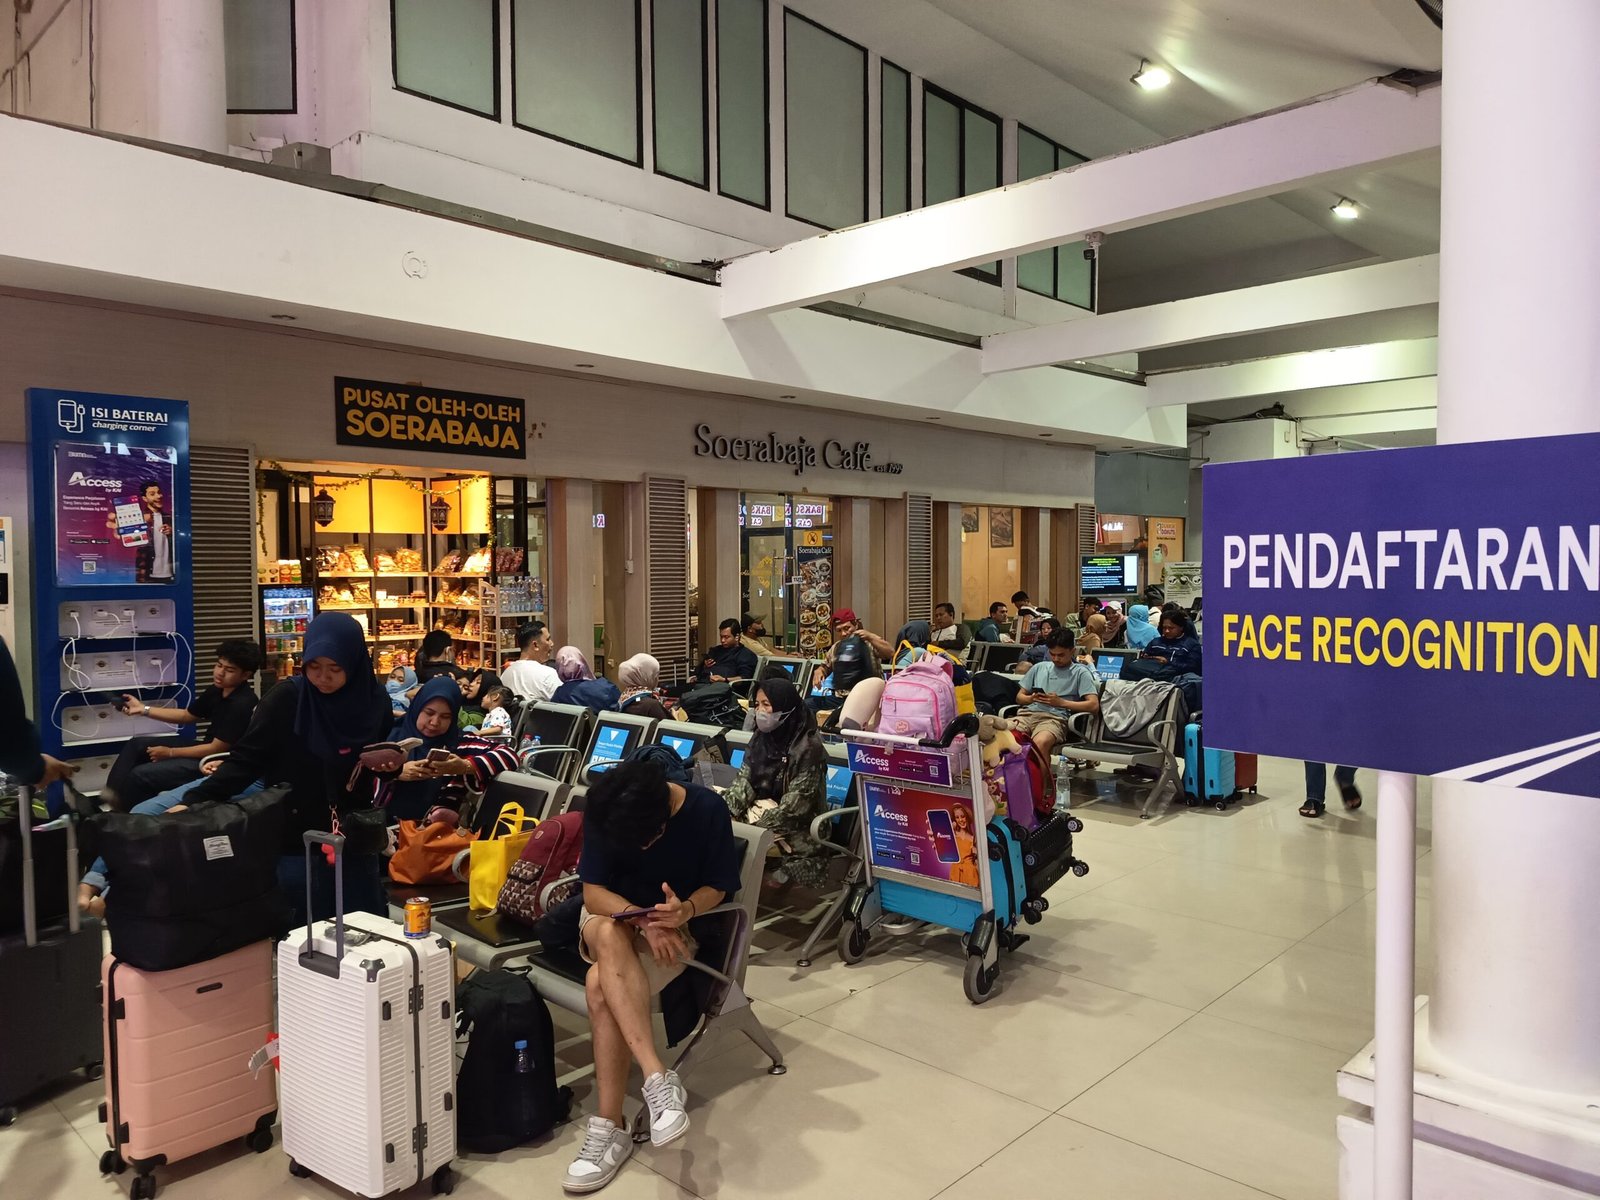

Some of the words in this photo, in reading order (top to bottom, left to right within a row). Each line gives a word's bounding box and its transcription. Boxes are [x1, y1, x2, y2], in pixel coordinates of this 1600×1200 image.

[91, 407, 108, 418] ISI
[112, 410, 168, 422] BATERAI
[343, 387, 410, 410] PUSAT
[415, 396, 521, 423] OLEH-OLEH
[92, 421, 128, 432] charging
[129, 424, 156, 432] corner
[346, 409, 520, 450] SOERABAJA
[695, 423, 817, 475] Soerabaja
[823, 439, 873, 471] Café
[68, 471, 122, 488] Access
[1223, 525, 1600, 591] PENDAFTARAN
[1223, 614, 1302, 661] FACE
[1312, 616, 1598, 679] RECOGNITION
[855, 749, 889, 767] Access
[874, 804, 908, 822] Access
